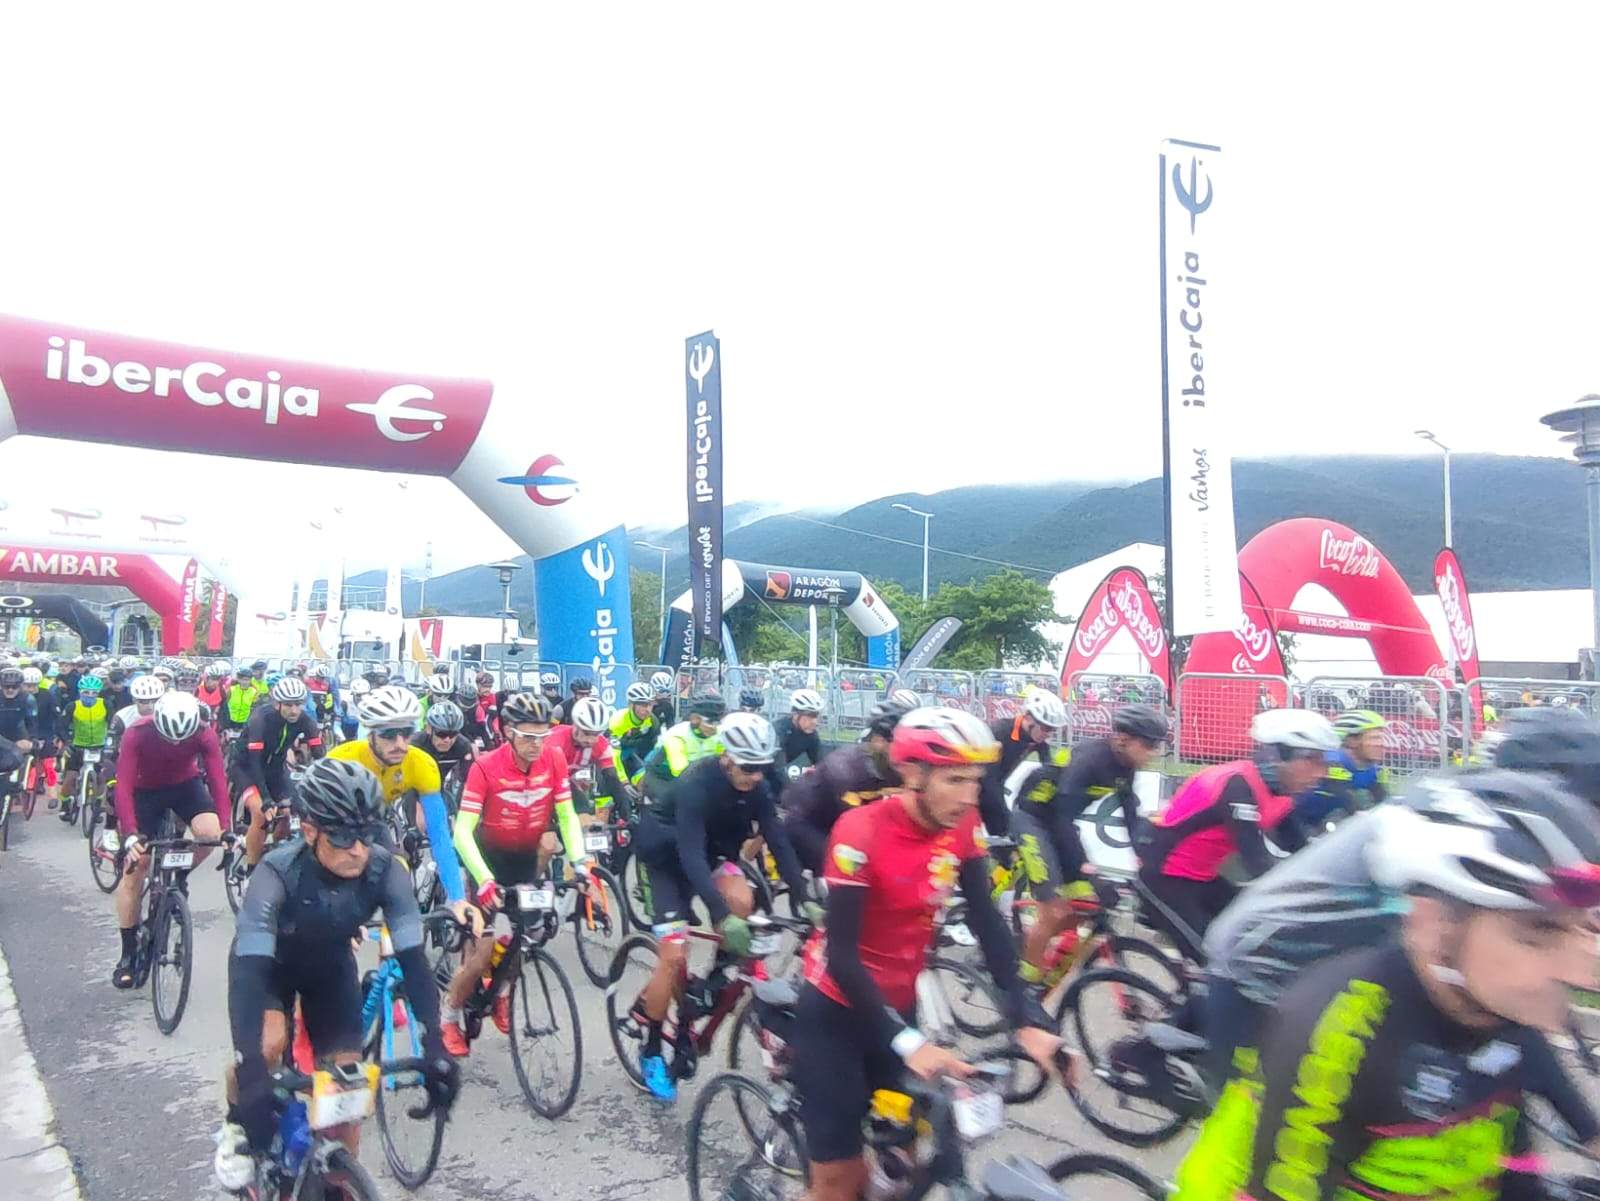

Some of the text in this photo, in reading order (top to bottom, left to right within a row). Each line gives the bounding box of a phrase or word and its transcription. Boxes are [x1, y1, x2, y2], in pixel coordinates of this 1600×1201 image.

[1176, 251, 1208, 408] iberCaja
[46, 335, 320, 425] iberCaja
[9, 550, 120, 578] AMBAR
[794, 574, 842, 588] ARAGÓN
[183, 576, 197, 623] AMBAR
[213, 584, 226, 622] AMBA
